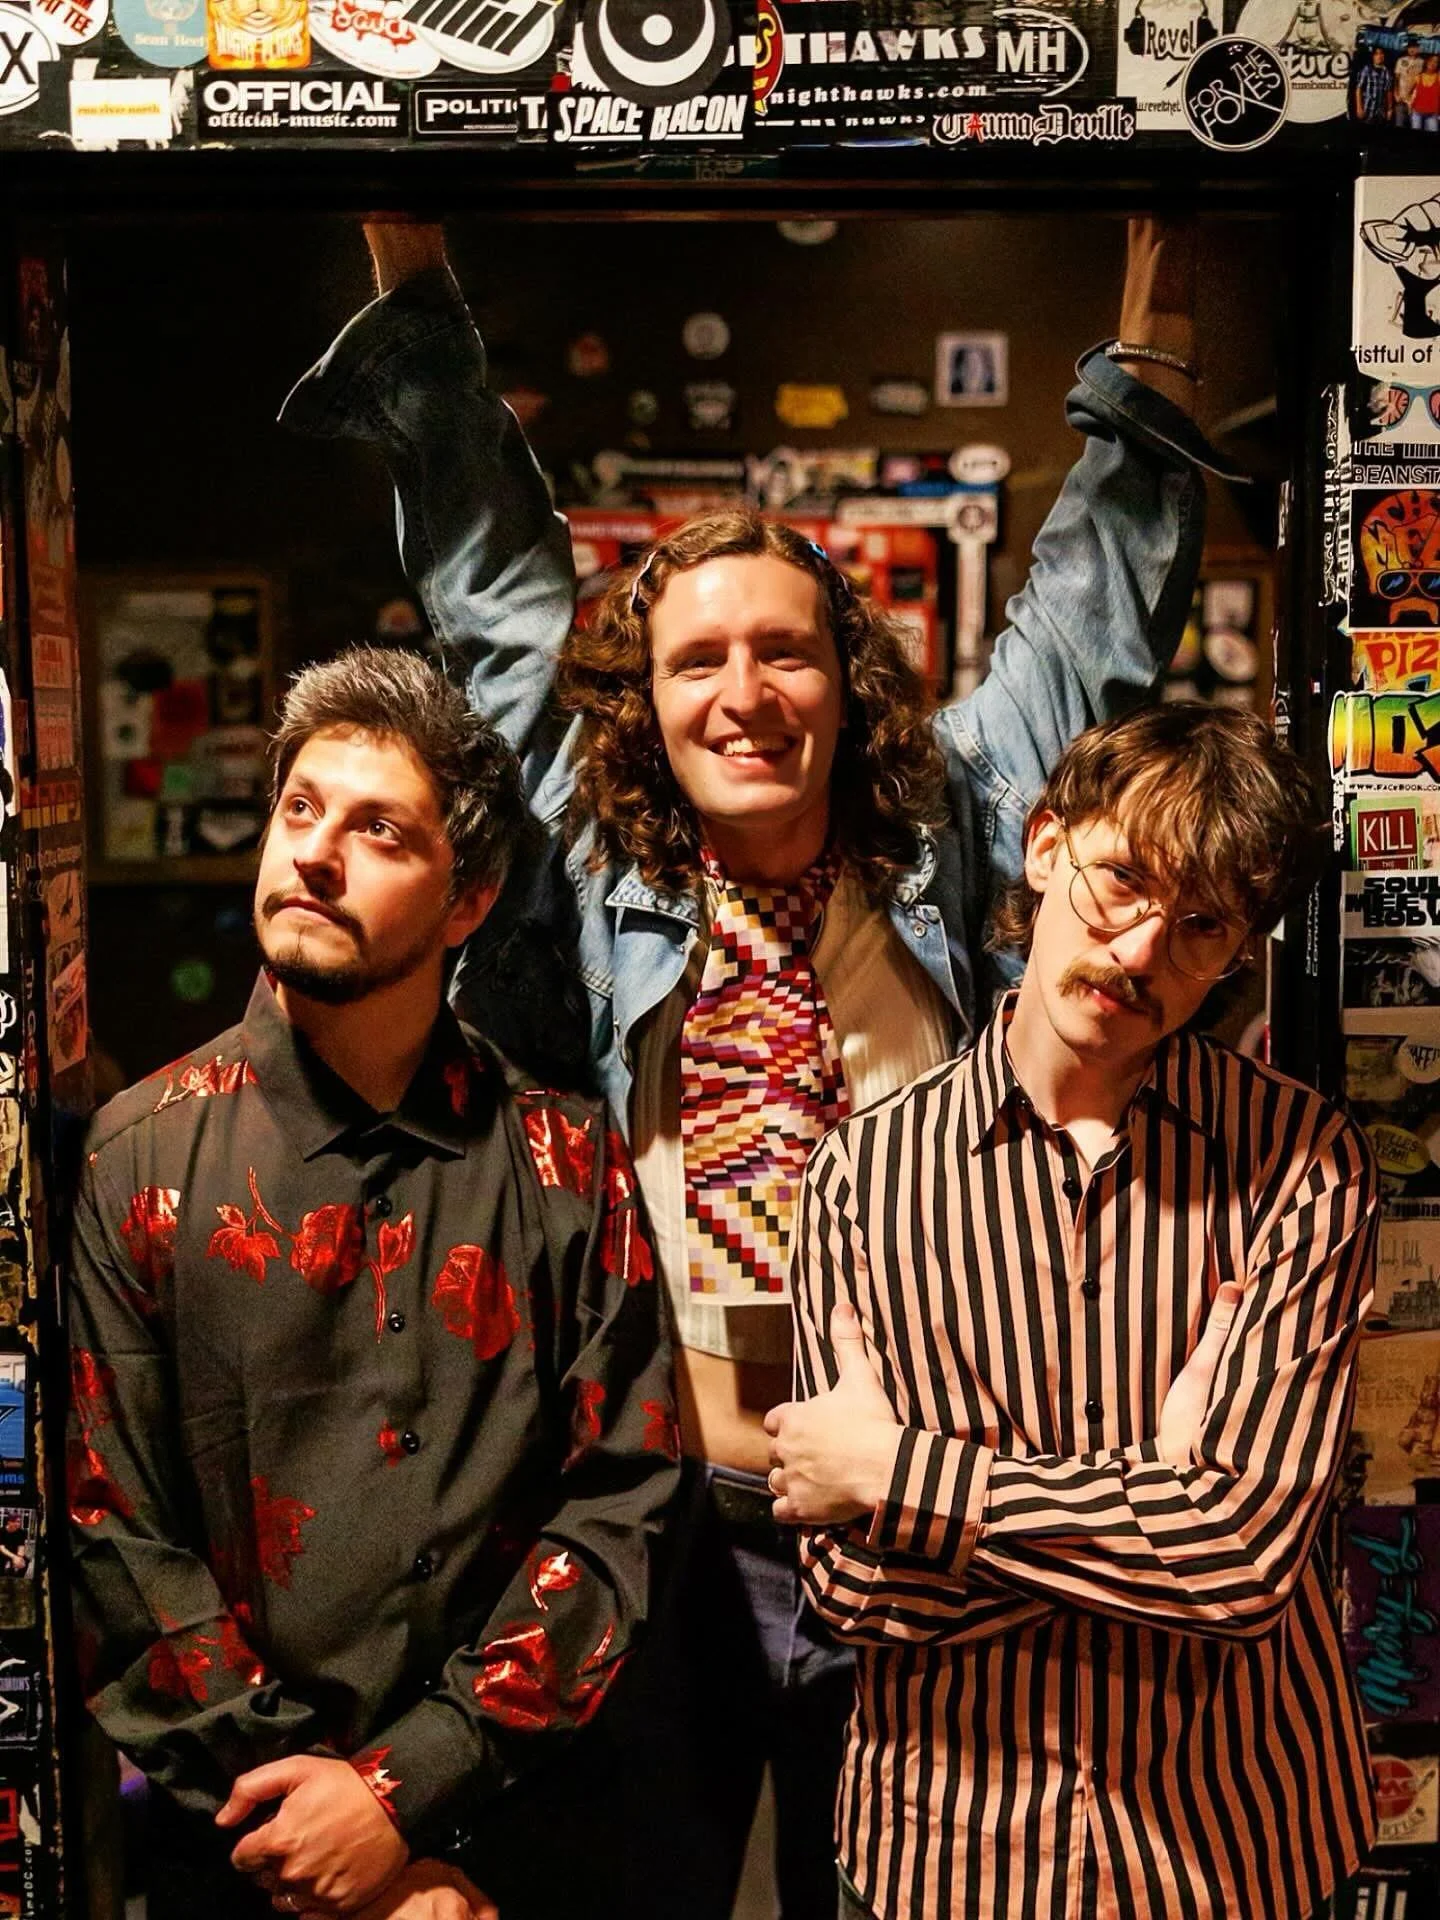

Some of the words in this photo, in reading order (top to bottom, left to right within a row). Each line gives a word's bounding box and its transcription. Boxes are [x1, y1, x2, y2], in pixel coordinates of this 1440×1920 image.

[997, 30, 1066, 73] MH
[203, 80, 400, 112] OFFICIAL
[770, 84, 987, 106] nighthawks.com
[208, 112, 397, 128] official-music.com
[553, 96, 643, 142] SPACE
[650, 94, 748, 142] BACON
[1354, 343, 1405, 365] istful
[1411, 343, 1434, 365] of
[1363, 815, 1413, 853] KILL
